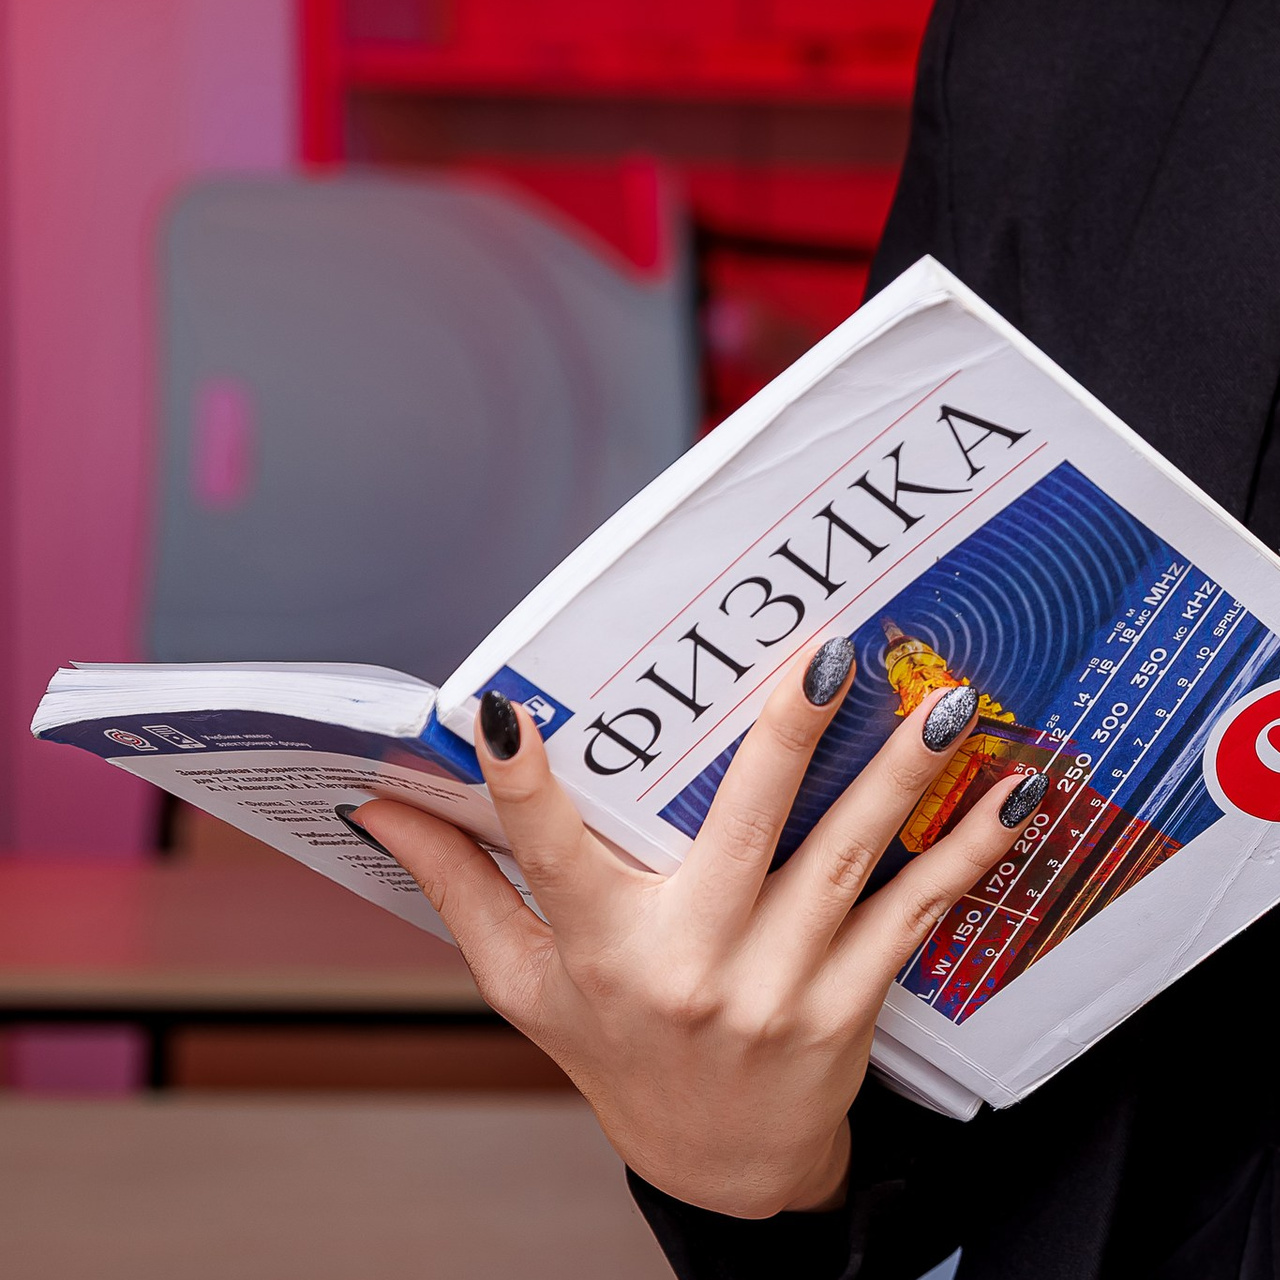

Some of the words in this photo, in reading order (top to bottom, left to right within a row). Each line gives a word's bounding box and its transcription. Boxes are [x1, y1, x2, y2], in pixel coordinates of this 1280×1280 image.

[584, 404, 1031, 776] ФИЗИКА
[1046, 714, 1060, 728] 25
[1089, 658, 1100, 669] 19
[1113, 621, 1126, 635] 16
[1126, 608, 1136, 618] M
[1049, 728, 1066, 742] 12
[1074, 692, 1090, 708] 14
[1097, 658, 1114, 674] 16
[1119, 628, 1136, 644] 18
[1134, 609, 1151, 626] MC
[1143, 562, 1184, 606] MHz
[175, 768, 253, 776] Завершённая
[252, 766, 321, 774] предметная
[931, 958, 952, 975] W
[952, 909, 982, 942] 150
[986, 862, 1015, 894] 170
[1015, 813, 1050, 854] 200
[1057, 752, 1092, 794] 250
[1091, 702, 1128, 743] 300
[1130, 648, 1168, 688] 350
[1173, 626, 1188, 641] KC
[985, 948, 995, 956] 0
[1027, 888, 1038, 897] 2
[1047, 859, 1059, 868] 3
[1070, 828, 1081, 838] 4
[1090, 798, 1102, 808] 5
[1112, 768, 1124, 778] 6
[1134, 738, 1144, 748] 7
[1155, 708, 1167, 718] 8
[1177, 678, 1188, 687] 9
[1196, 646, 1210, 660] 10
